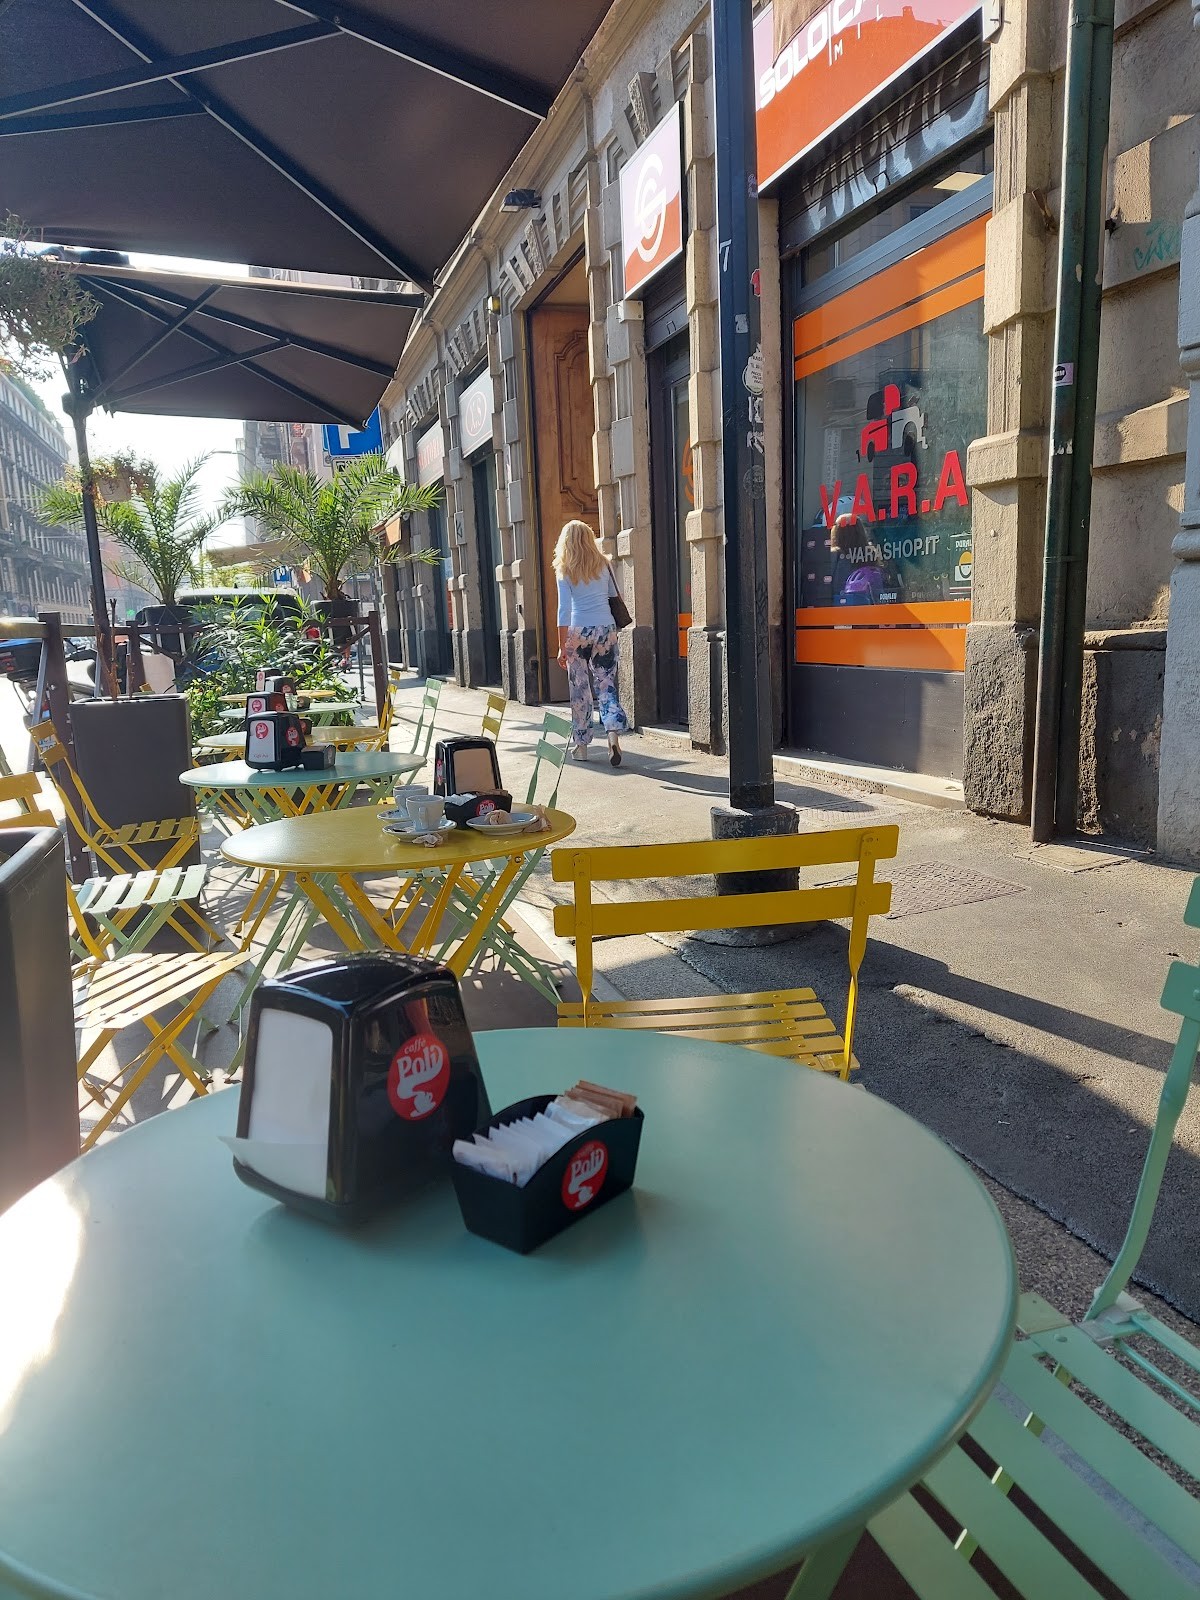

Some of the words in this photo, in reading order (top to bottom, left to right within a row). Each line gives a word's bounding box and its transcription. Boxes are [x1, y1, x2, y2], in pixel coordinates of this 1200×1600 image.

[759, 11, 829, 108] SOLO
[849, 535, 940, 564] VARASHOP.IT
[397, 1045, 443, 1082] Poli
[571, 1148, 604, 1183] Poli
